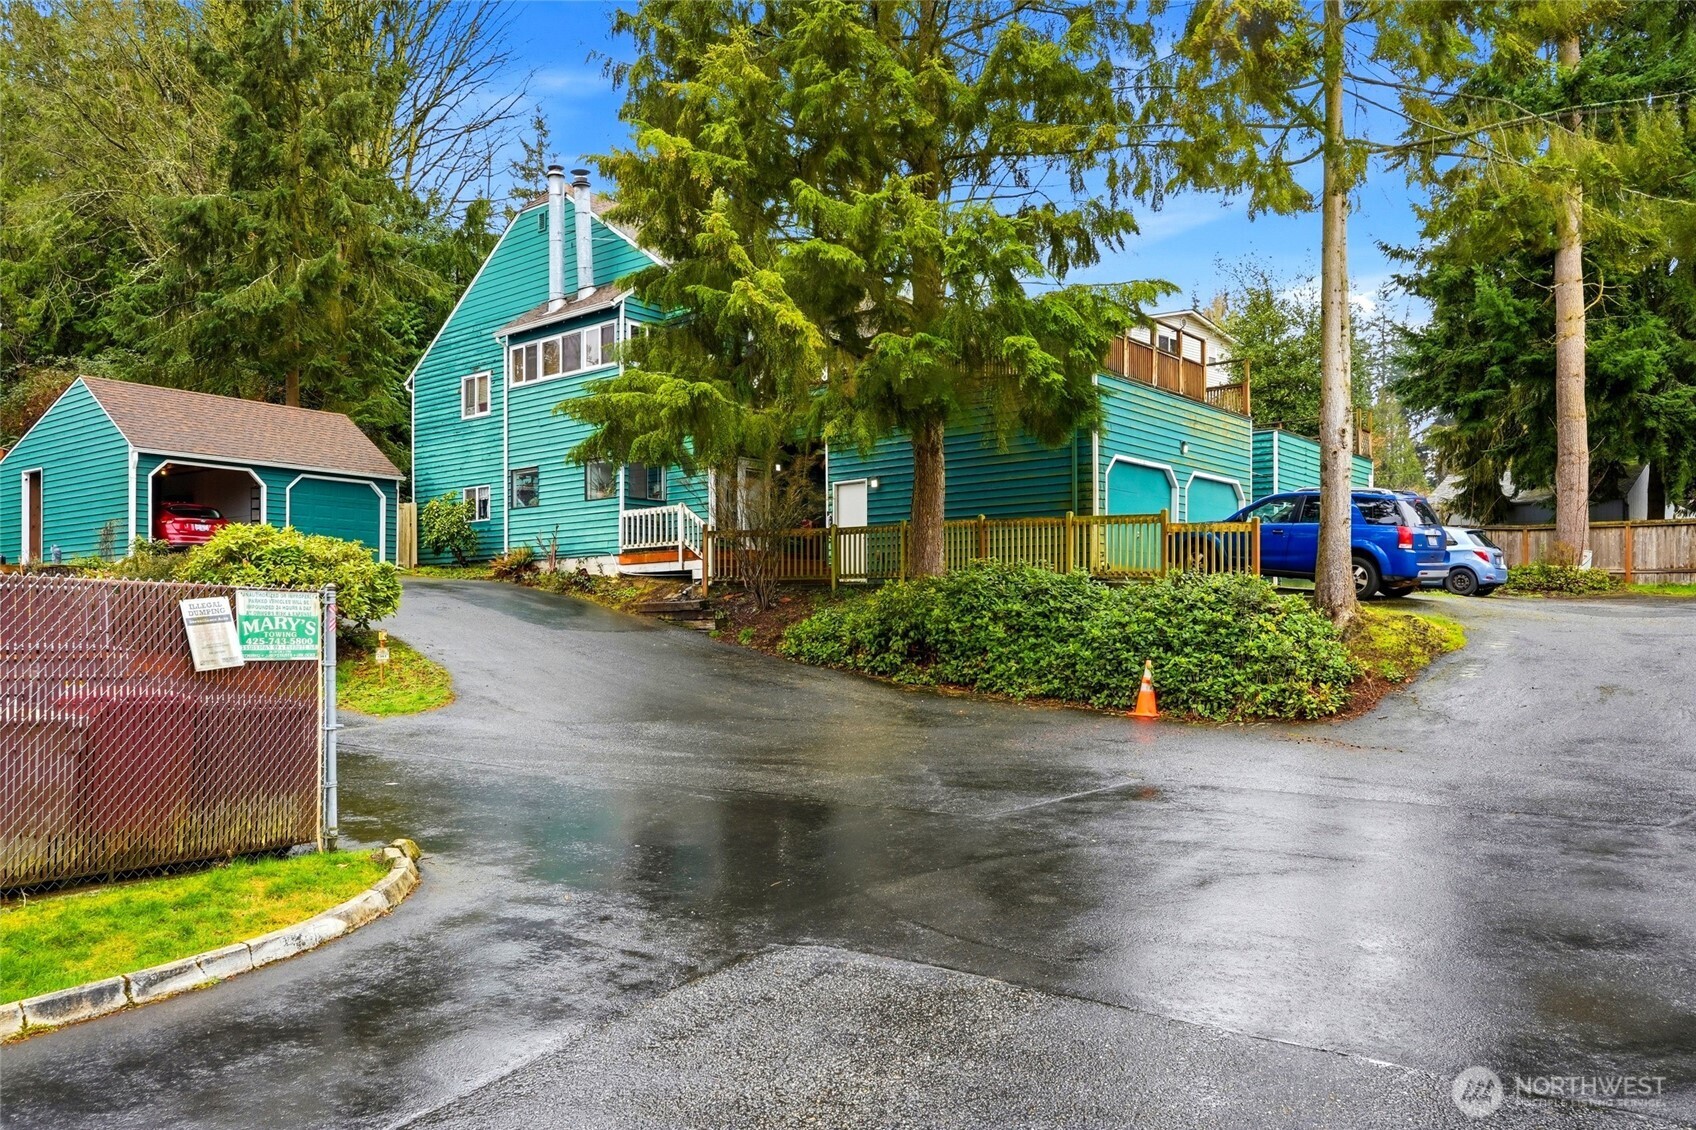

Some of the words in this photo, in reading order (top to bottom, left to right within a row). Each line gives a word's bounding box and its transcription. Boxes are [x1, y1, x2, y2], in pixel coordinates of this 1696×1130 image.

[188, 601, 223, 610] ILLEGAL
[187, 607, 226, 616] DUMPING
[242, 616, 316, 636] MARY'S
[245, 637, 313, 645] 425-743-5800
